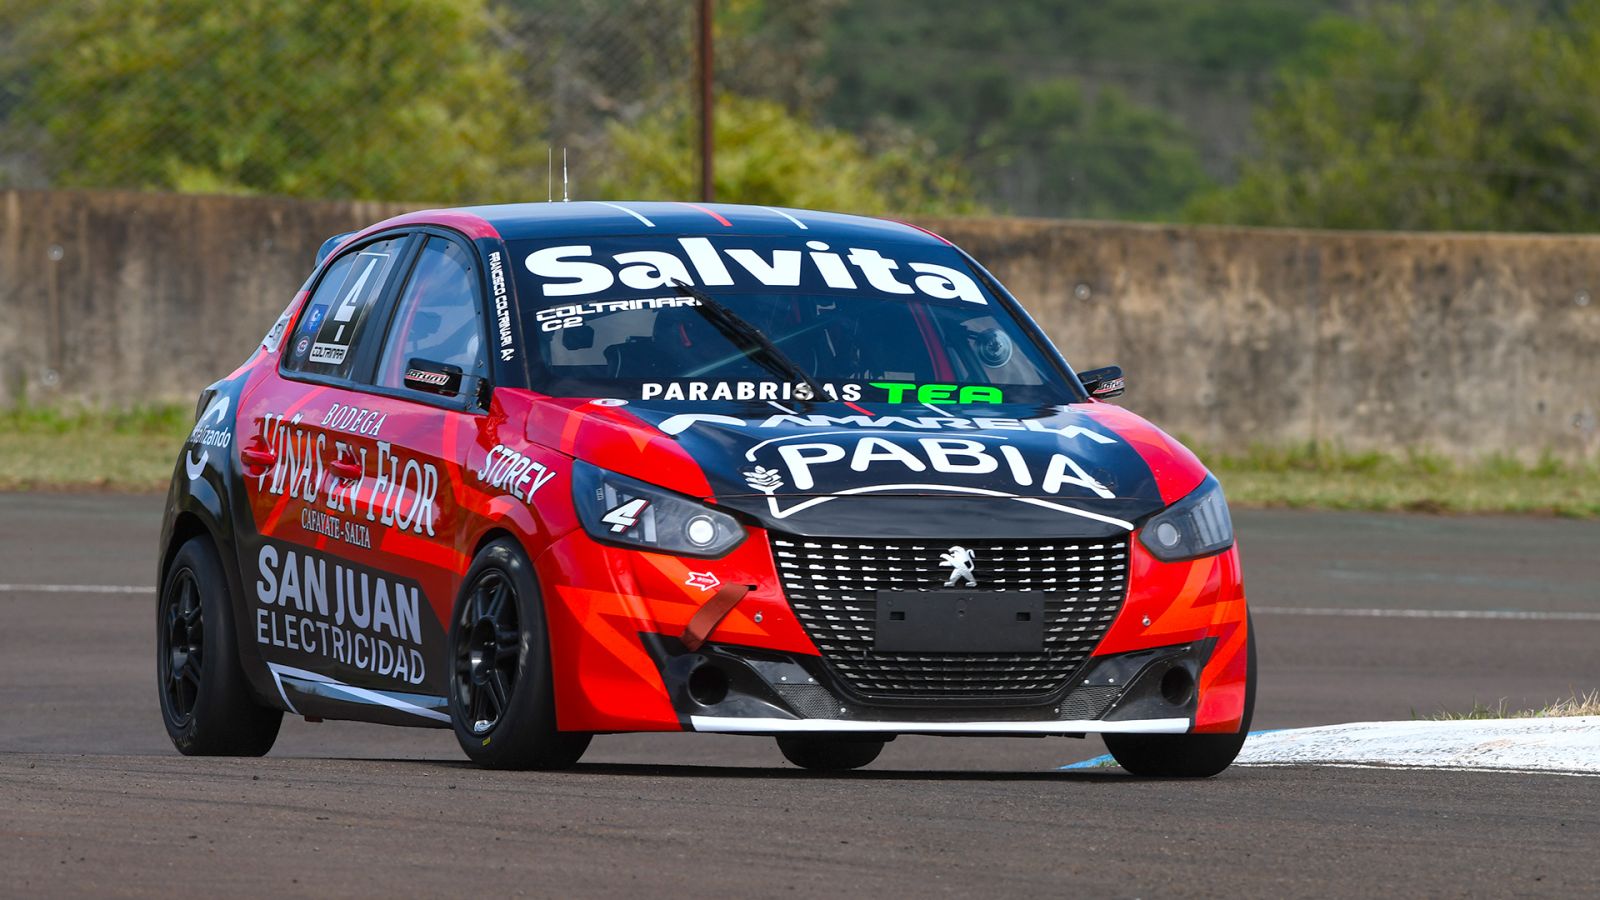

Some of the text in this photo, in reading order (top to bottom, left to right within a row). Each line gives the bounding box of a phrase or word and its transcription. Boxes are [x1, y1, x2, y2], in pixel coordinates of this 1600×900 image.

[334, 258, 378, 342] 4
[488, 251, 506, 296] FRANCISCO
[525, 237, 988, 305] Salvita
[541, 316, 583, 332] C2
[320, 403, 388, 437] BODEGA
[868, 381, 1003, 405] TEA
[258, 412, 438, 537] VIÑAS EN FLOR
[477, 444, 557, 505] STOREY
[777, 437, 1117, 499] PABIA
[344, 521, 371, 549] SALTA
[601, 499, 649, 533] 4
[257, 544, 422, 645] SAN JUAN
[257, 608, 425, 685] ELECTRICIDAD
